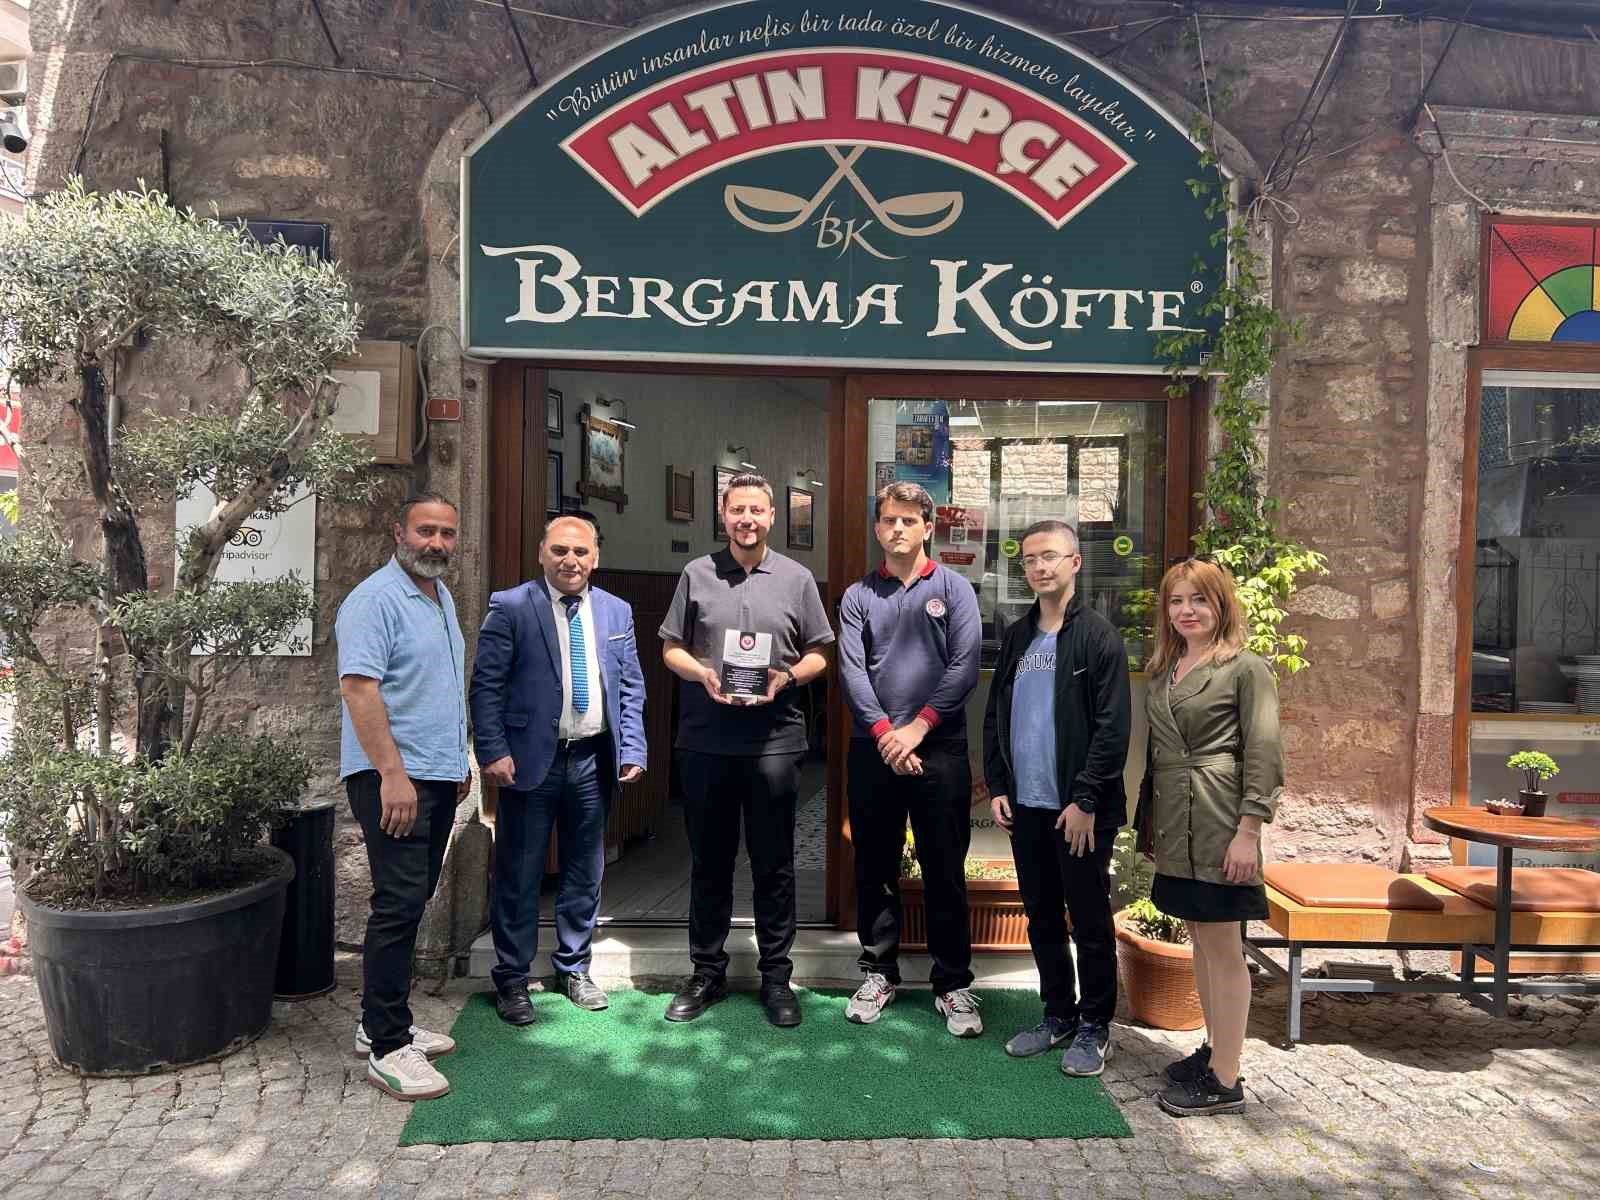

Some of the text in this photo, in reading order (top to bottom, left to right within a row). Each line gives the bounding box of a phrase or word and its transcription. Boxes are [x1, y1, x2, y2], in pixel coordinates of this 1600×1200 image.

[642, 30, 734, 75] insanlar
[739, 14, 795, 48] nefis
[800, 9, 832, 33] bir
[838, 9, 885, 33] tada
[890, 17, 941, 41] özel
[944, 23, 977, 51] bir
[979, 34, 1060, 85] hizmete
[608, 65, 1101, 201] ALTIN KEPÇE
[812, 200, 907, 261] BK
[480, 244, 903, 329] BERGAMA
[927, 259, 1206, 351] KÖFTE
[220, 551, 269, 560] ripadvisor
